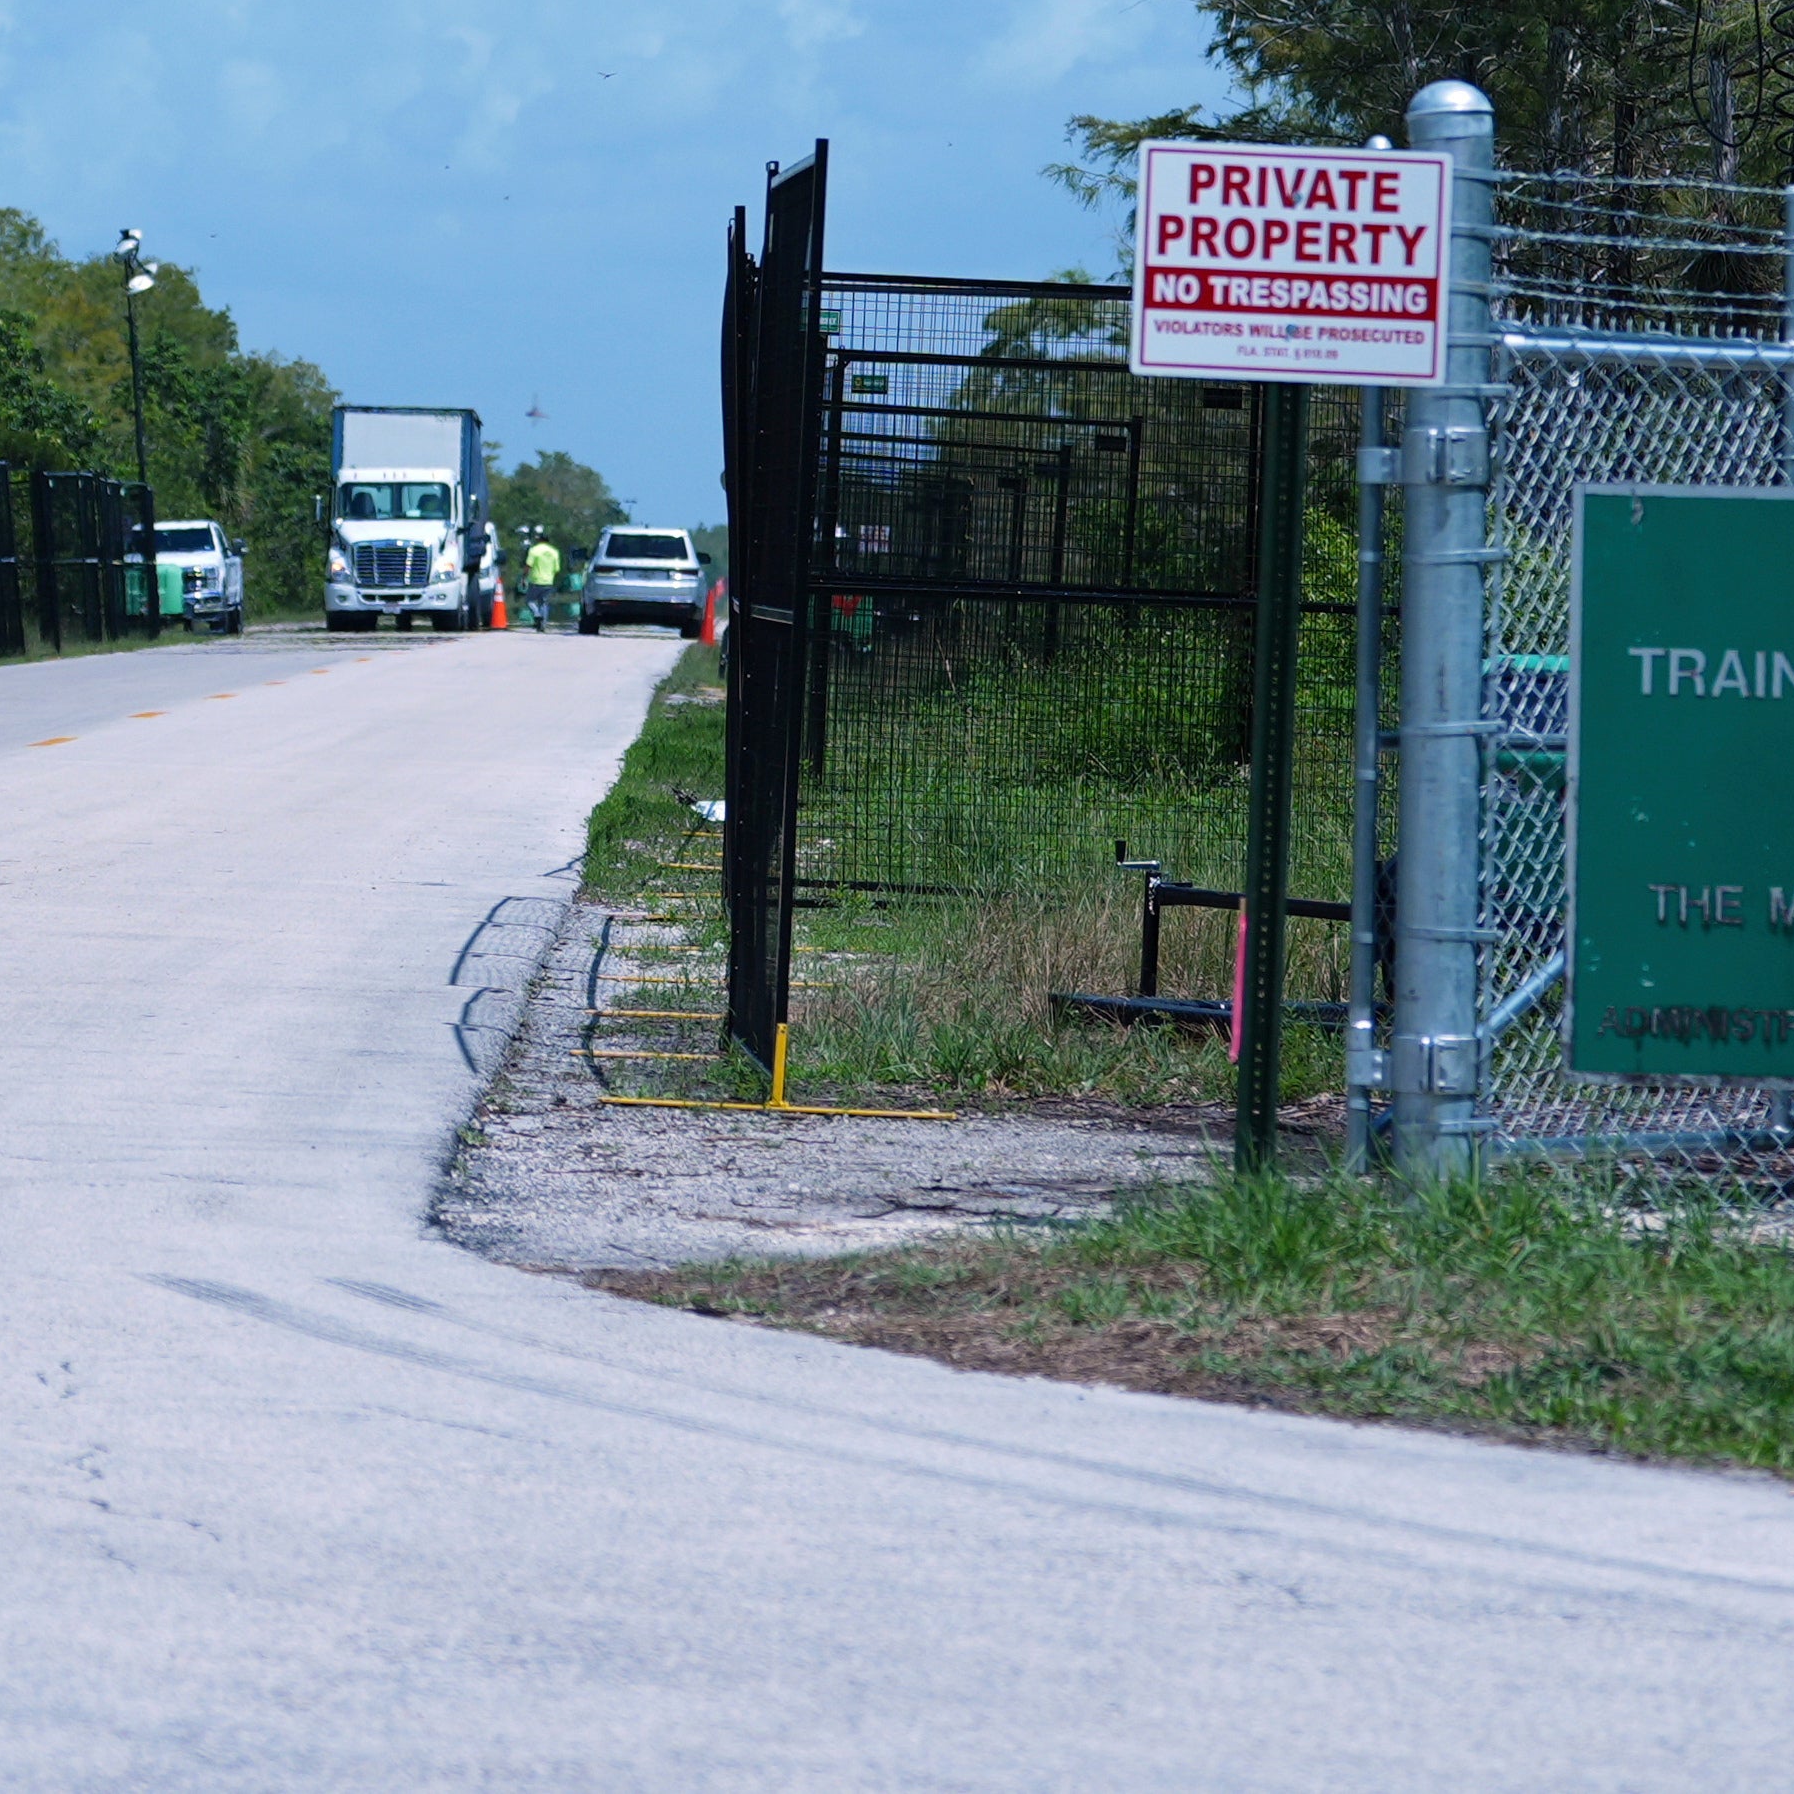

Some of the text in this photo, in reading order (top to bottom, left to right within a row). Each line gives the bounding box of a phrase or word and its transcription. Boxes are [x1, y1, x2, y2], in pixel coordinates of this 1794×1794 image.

[1188, 163, 1400, 213] PRIVATE
[1157, 214, 1427, 266] PROPERTY
[1152, 273, 1427, 314] NO TRESPASSING
[1154, 320, 1243, 337] VIOLATORS
[1249, 324, 1287, 339] WILL
[1317, 326, 1425, 344] PROSECUTED
[1647, 883, 1745, 927] THE
